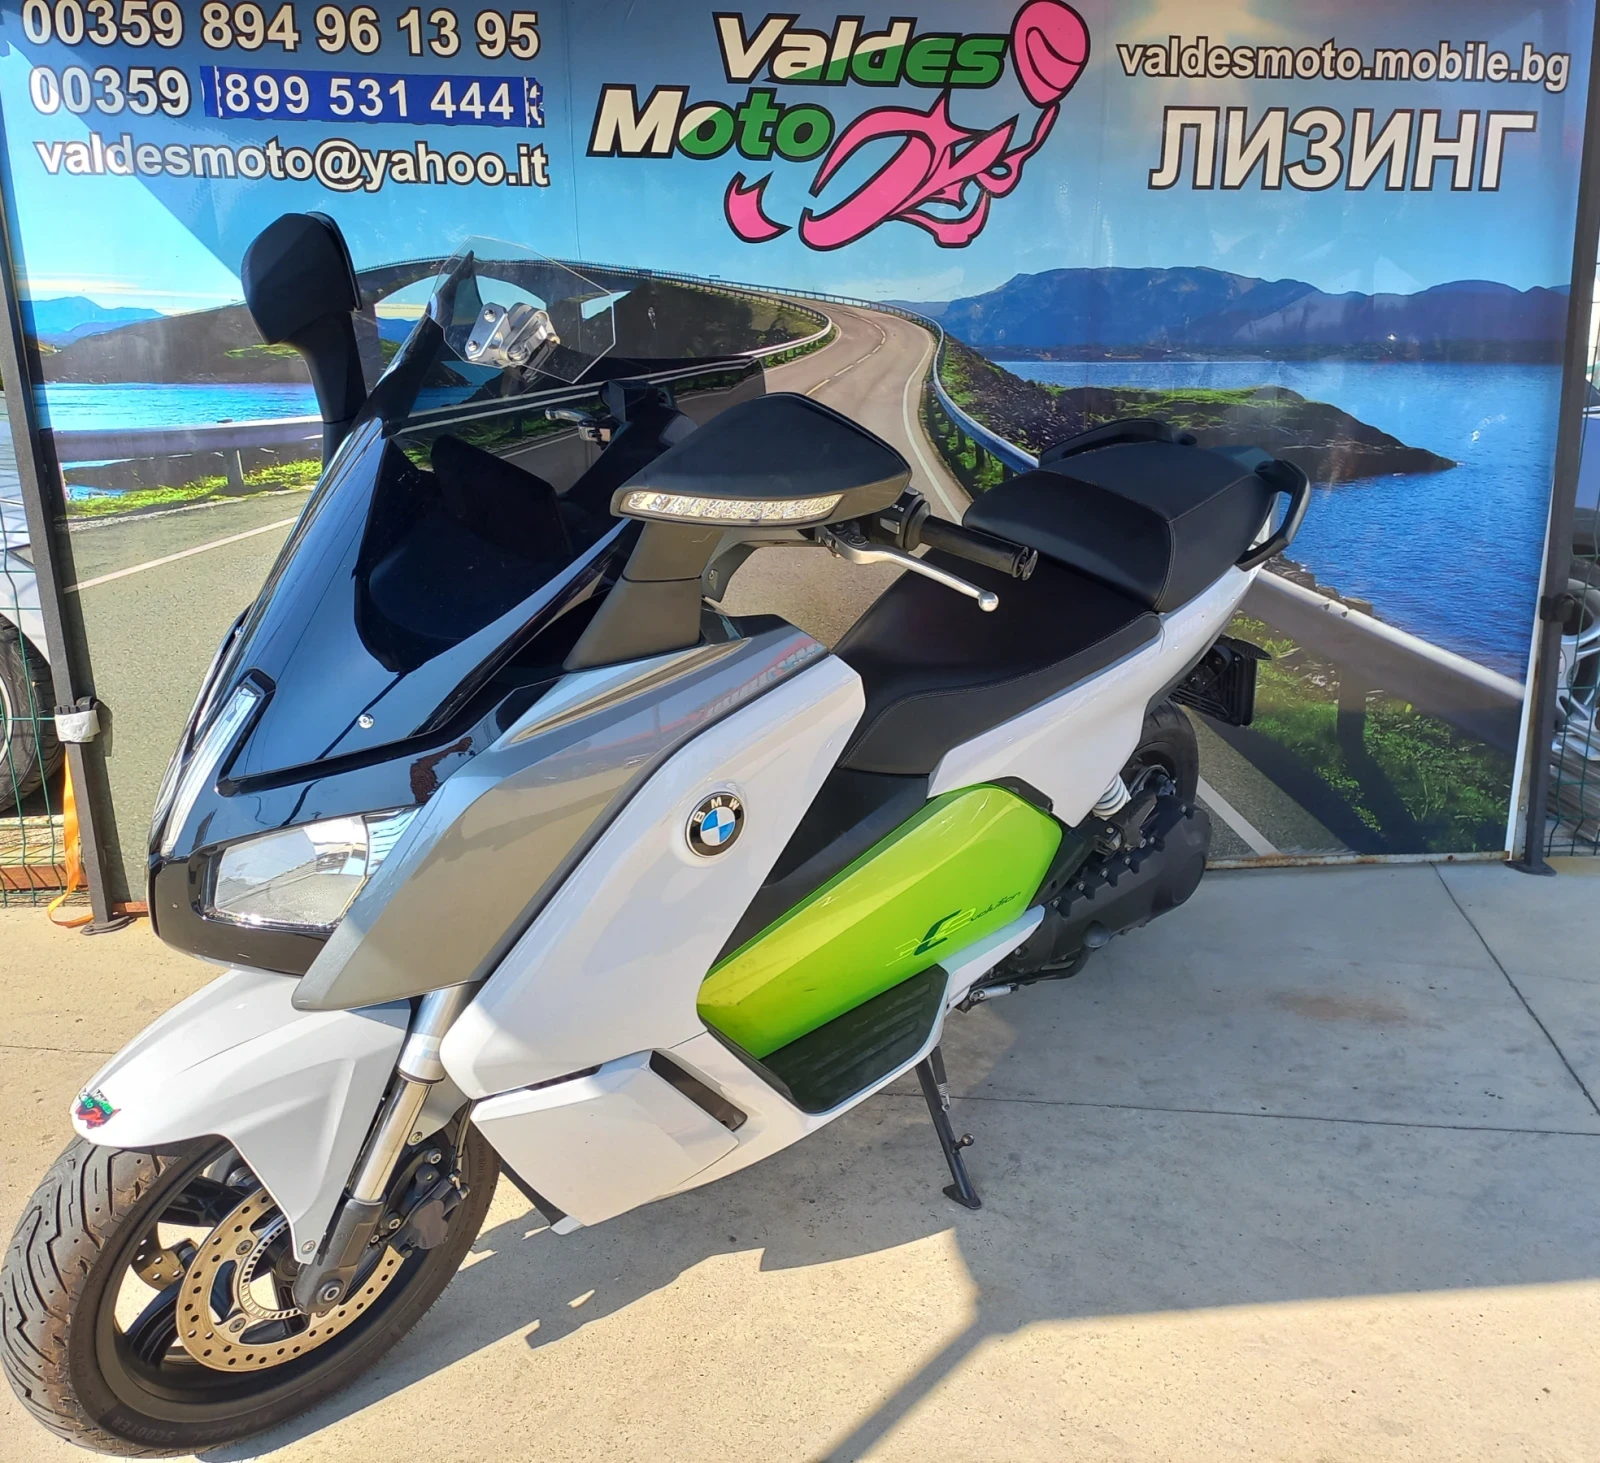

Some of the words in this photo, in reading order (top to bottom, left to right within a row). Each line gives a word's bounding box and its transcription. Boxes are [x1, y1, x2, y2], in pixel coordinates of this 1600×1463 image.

[22, 0, 184, 48] 00359
[202, 1, 299, 51] 894
[315, 3, 381, 55] 96
[397, 5, 460, 57] 13
[475, 9, 542, 60] 95
[712, 12, 1010, 89] Valdes
[29, 66, 191, 118] 00359
[224, 73, 310, 115] 899
[328, 77, 408, 117] 531
[430, 80, 514, 120] 444
[1116, 35, 1571, 95] valdesmoto.mobile.bg
[586, 83, 835, 163] Moto
[1148, 105, 1538, 192] ЛИЗИНГ
[33, 131, 550, 193] valdesmoto@yahoo.it
[693, 796, 740, 823] BMW
